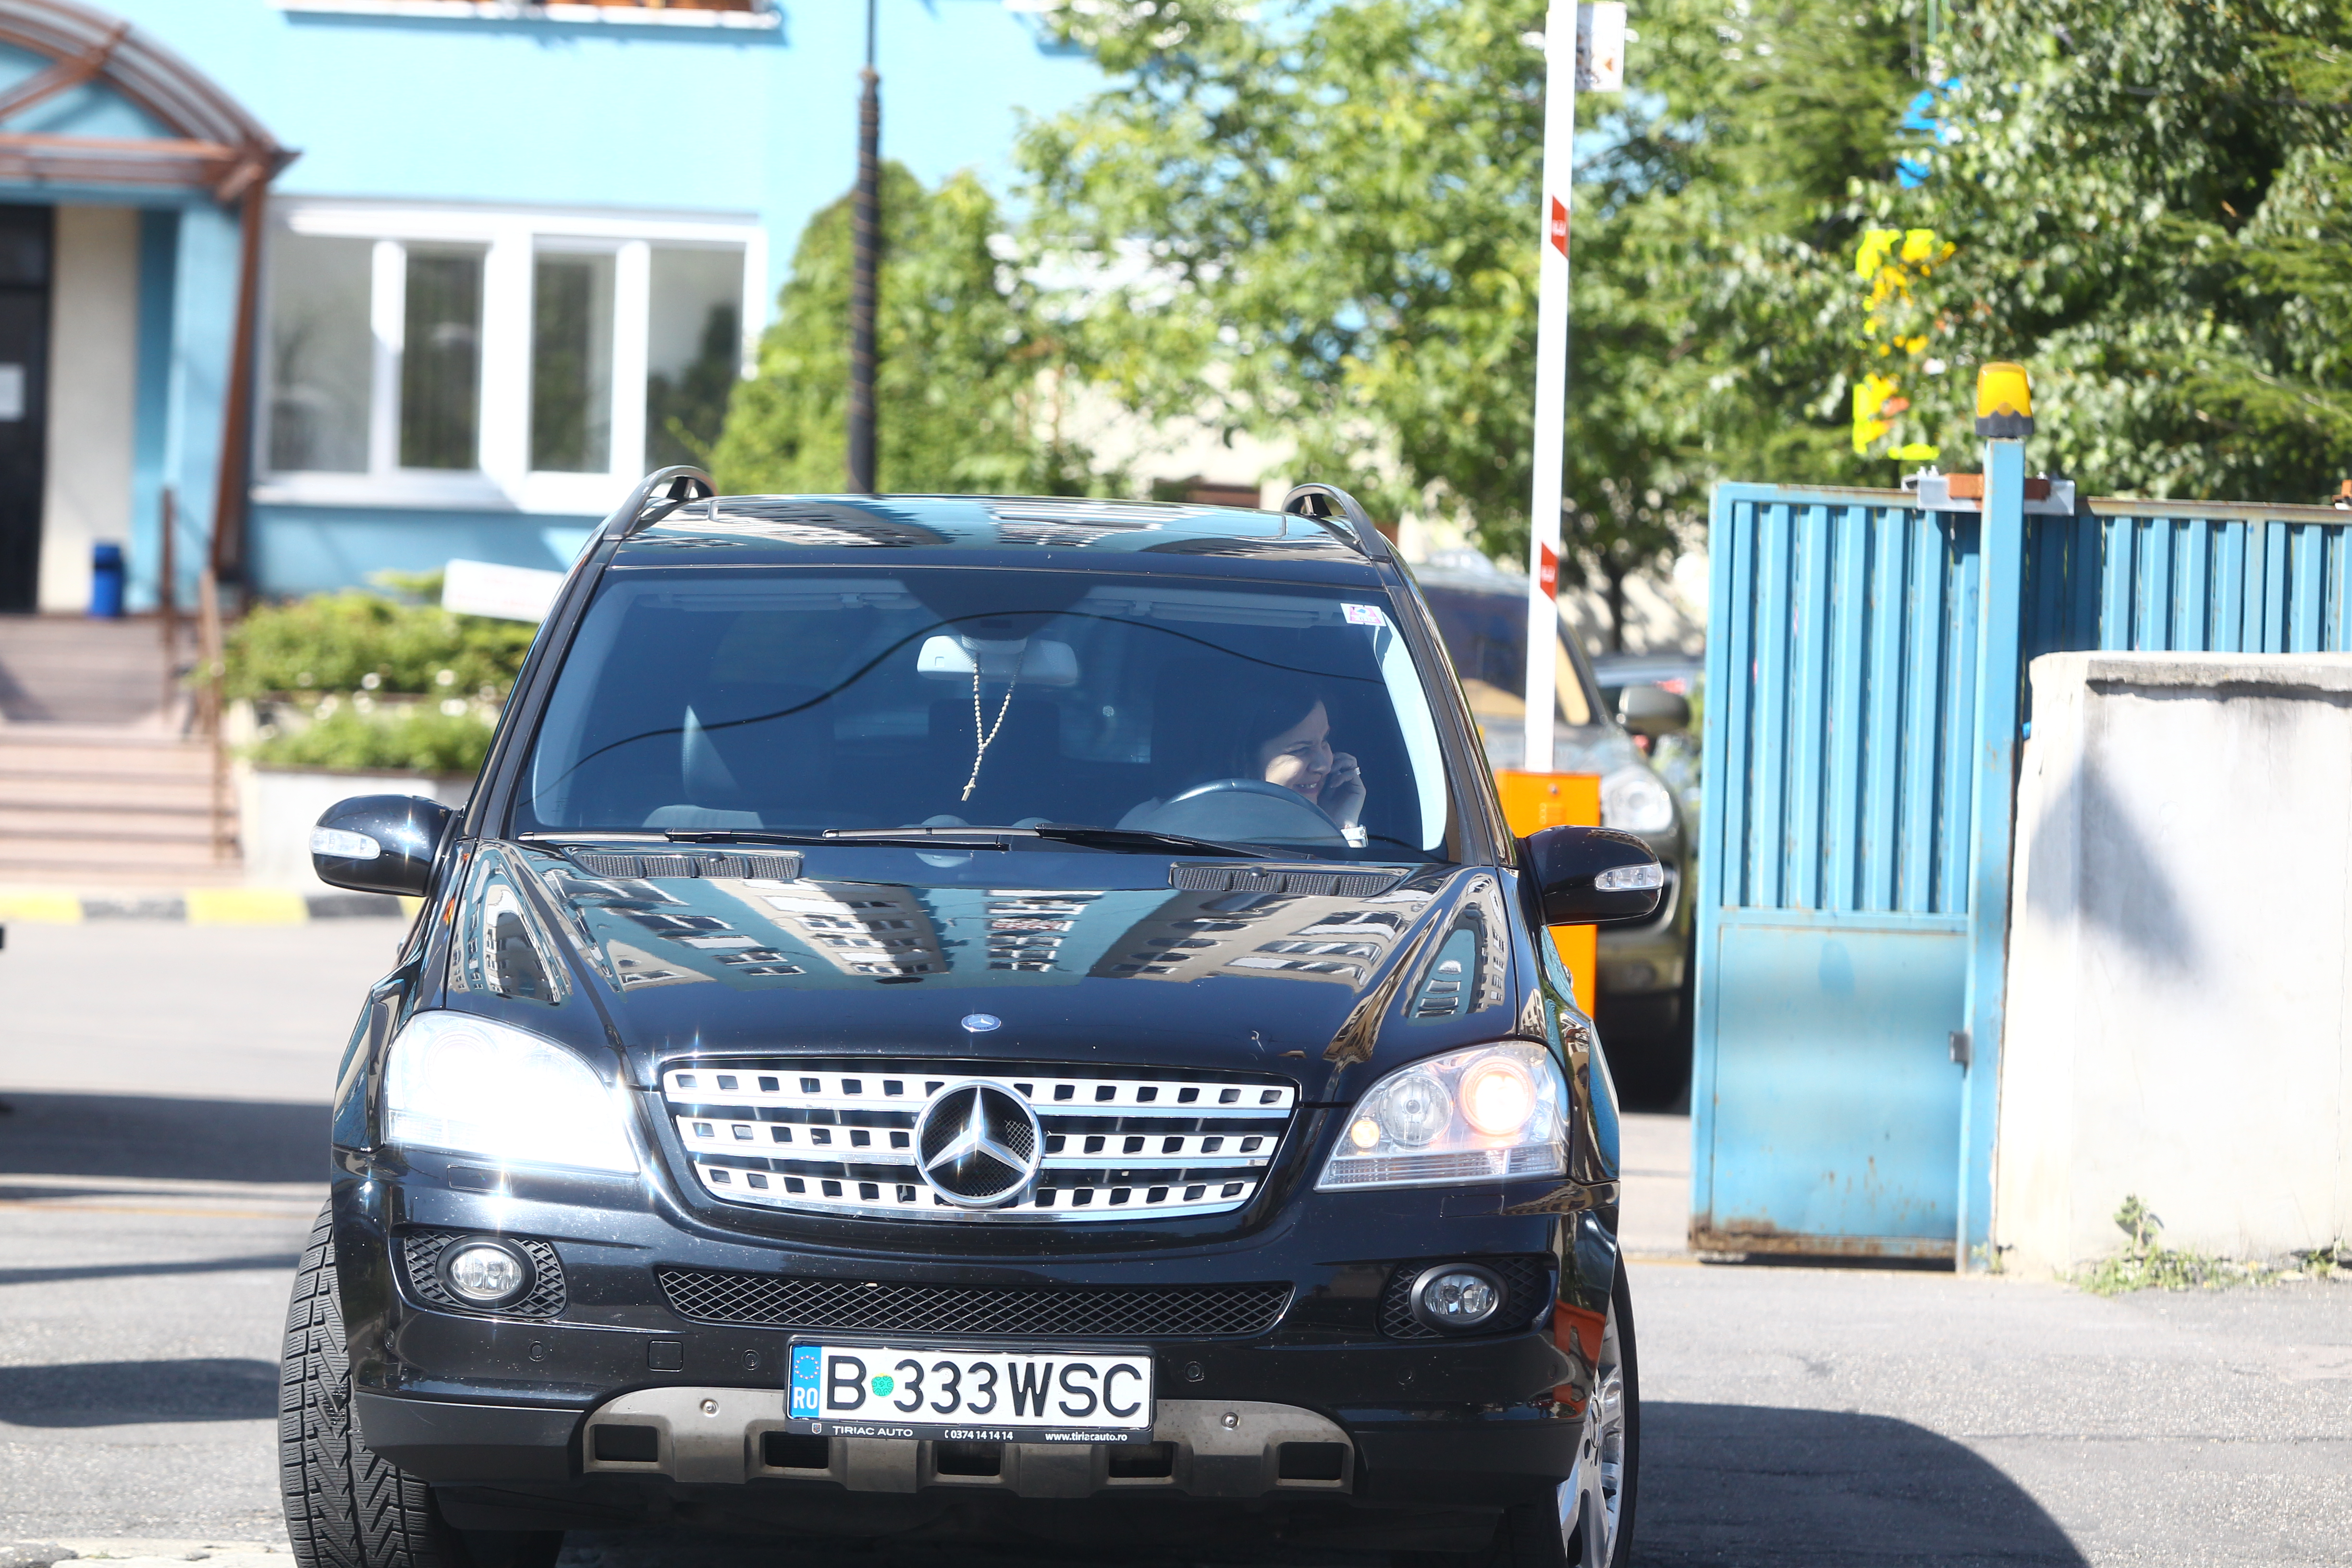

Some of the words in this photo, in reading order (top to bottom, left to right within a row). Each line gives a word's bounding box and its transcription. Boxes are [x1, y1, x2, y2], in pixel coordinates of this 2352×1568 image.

[827, 1355, 867, 1410] B
[793, 1386, 818, 1409] RO
[832, 1426, 875, 1435] TIRIAC
[877, 1428, 913, 1437] AUTO
[951, 1430, 974, 1439] 0374
[1045, 1432, 1127, 1441] www.tiriacauto.ro
